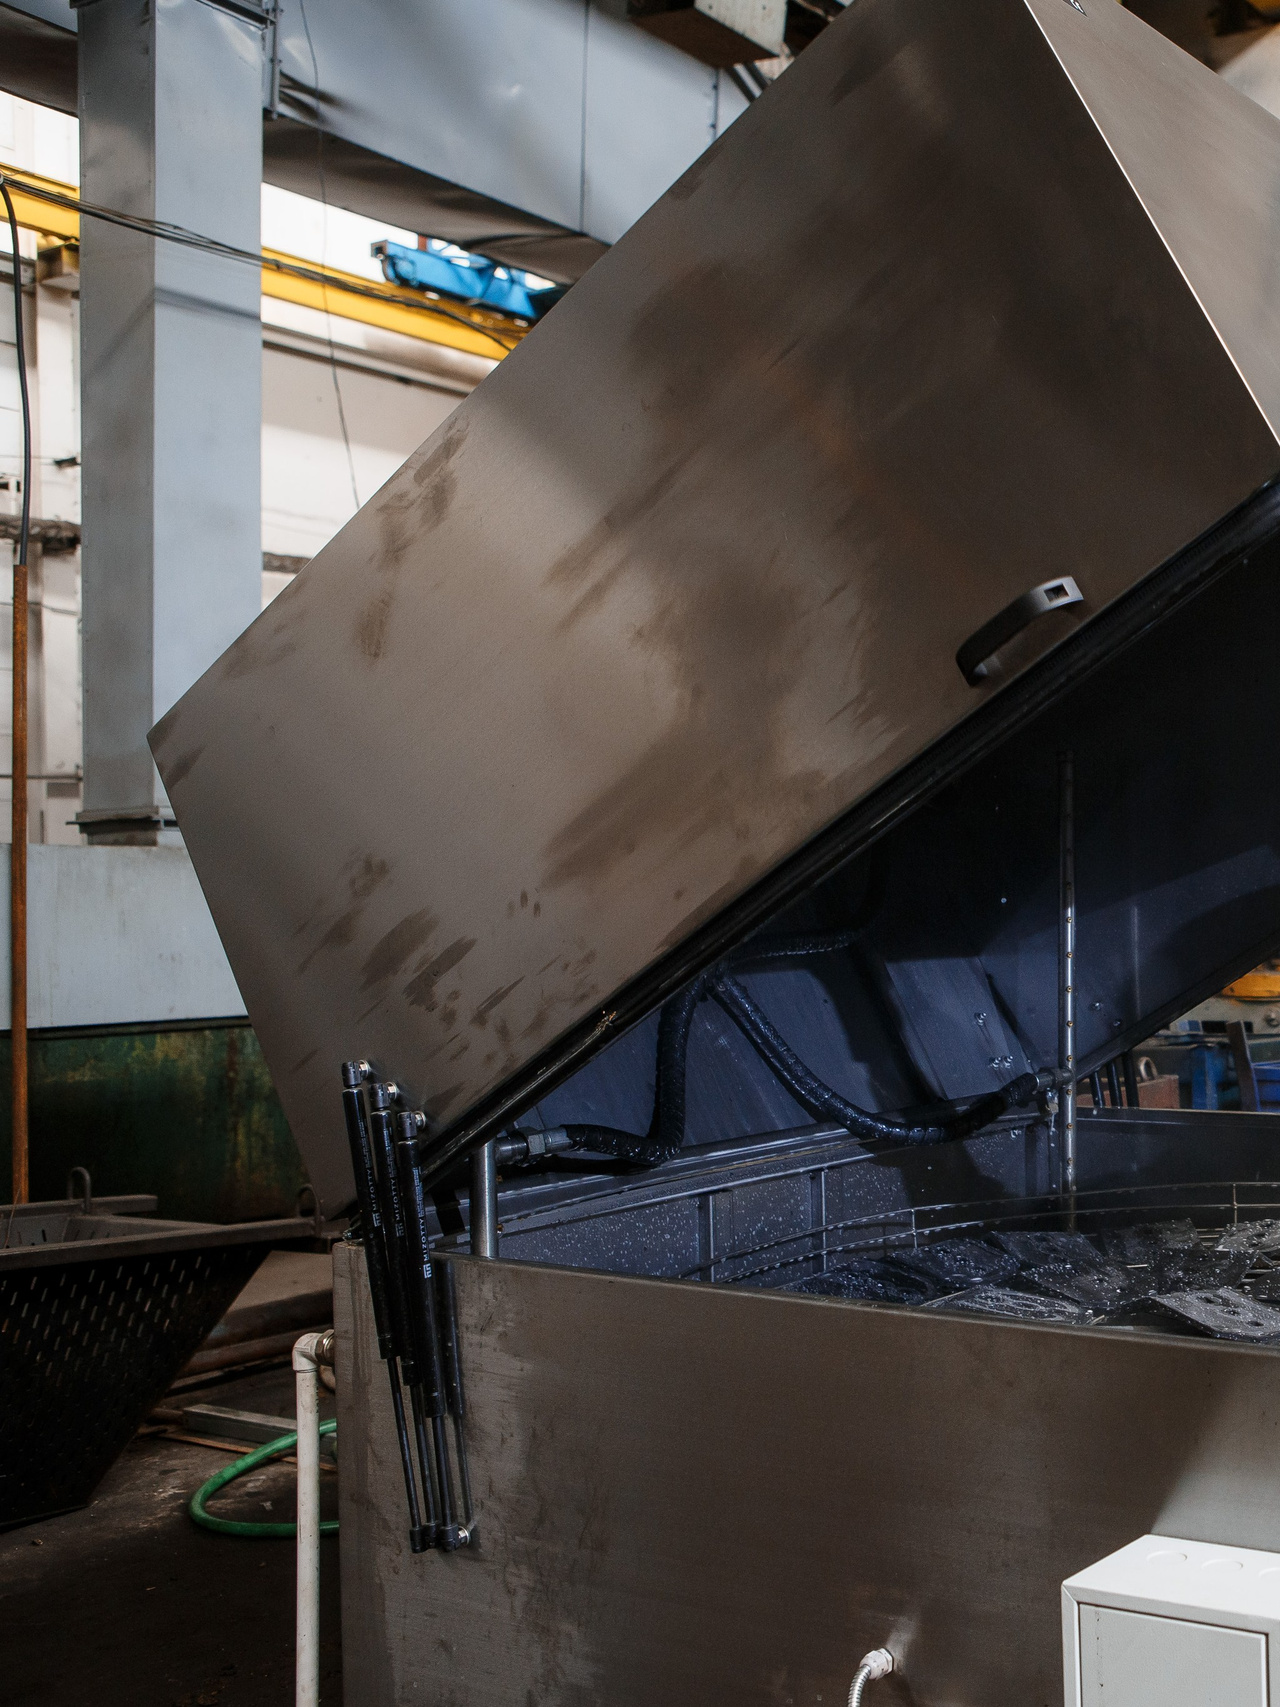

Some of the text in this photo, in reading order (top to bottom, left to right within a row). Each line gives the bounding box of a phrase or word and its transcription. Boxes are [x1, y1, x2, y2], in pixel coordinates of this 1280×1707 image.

[366, 1168, 377, 1211] MIZOTTY
[390, 1178, 400, 1221] MIZOTTY
[418, 1218, 431, 1262] MIZOTTY
